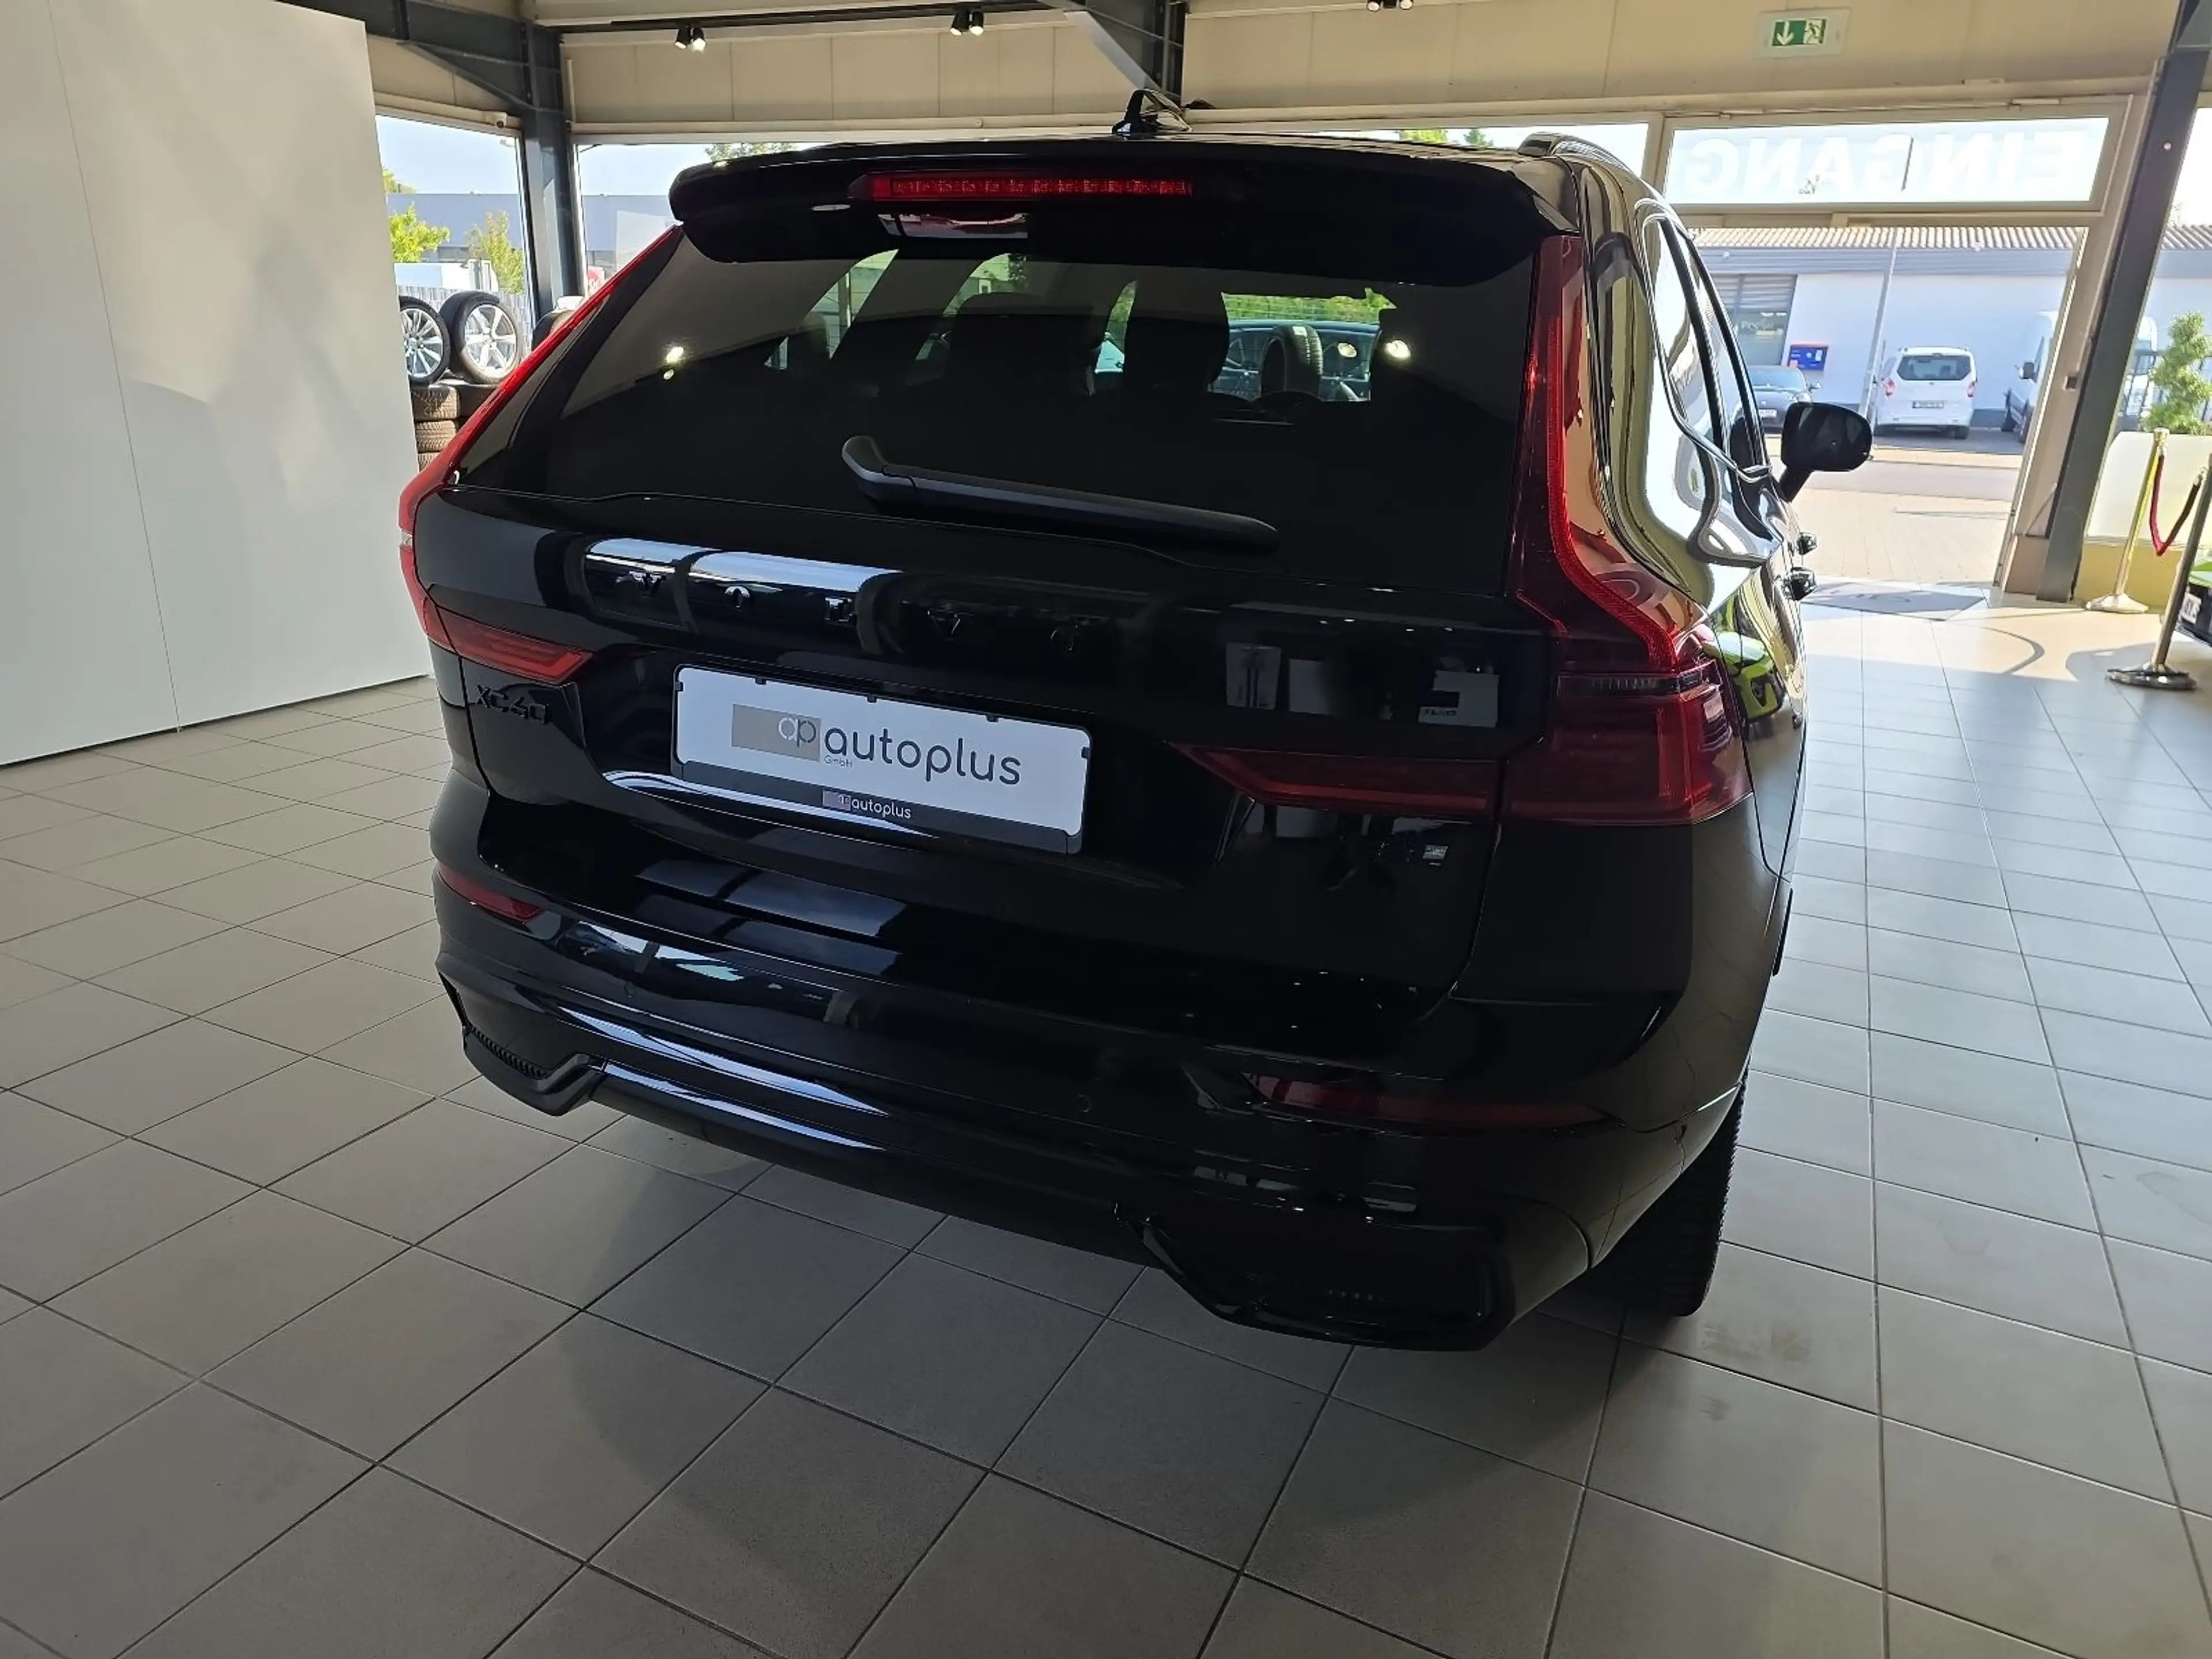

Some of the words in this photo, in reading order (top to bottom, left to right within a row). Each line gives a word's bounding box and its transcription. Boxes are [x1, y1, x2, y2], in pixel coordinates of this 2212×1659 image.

[824, 727, 1021, 785] autoplus
[824, 755, 853, 768] GmbH
[851, 798, 912, 819] autoplus
